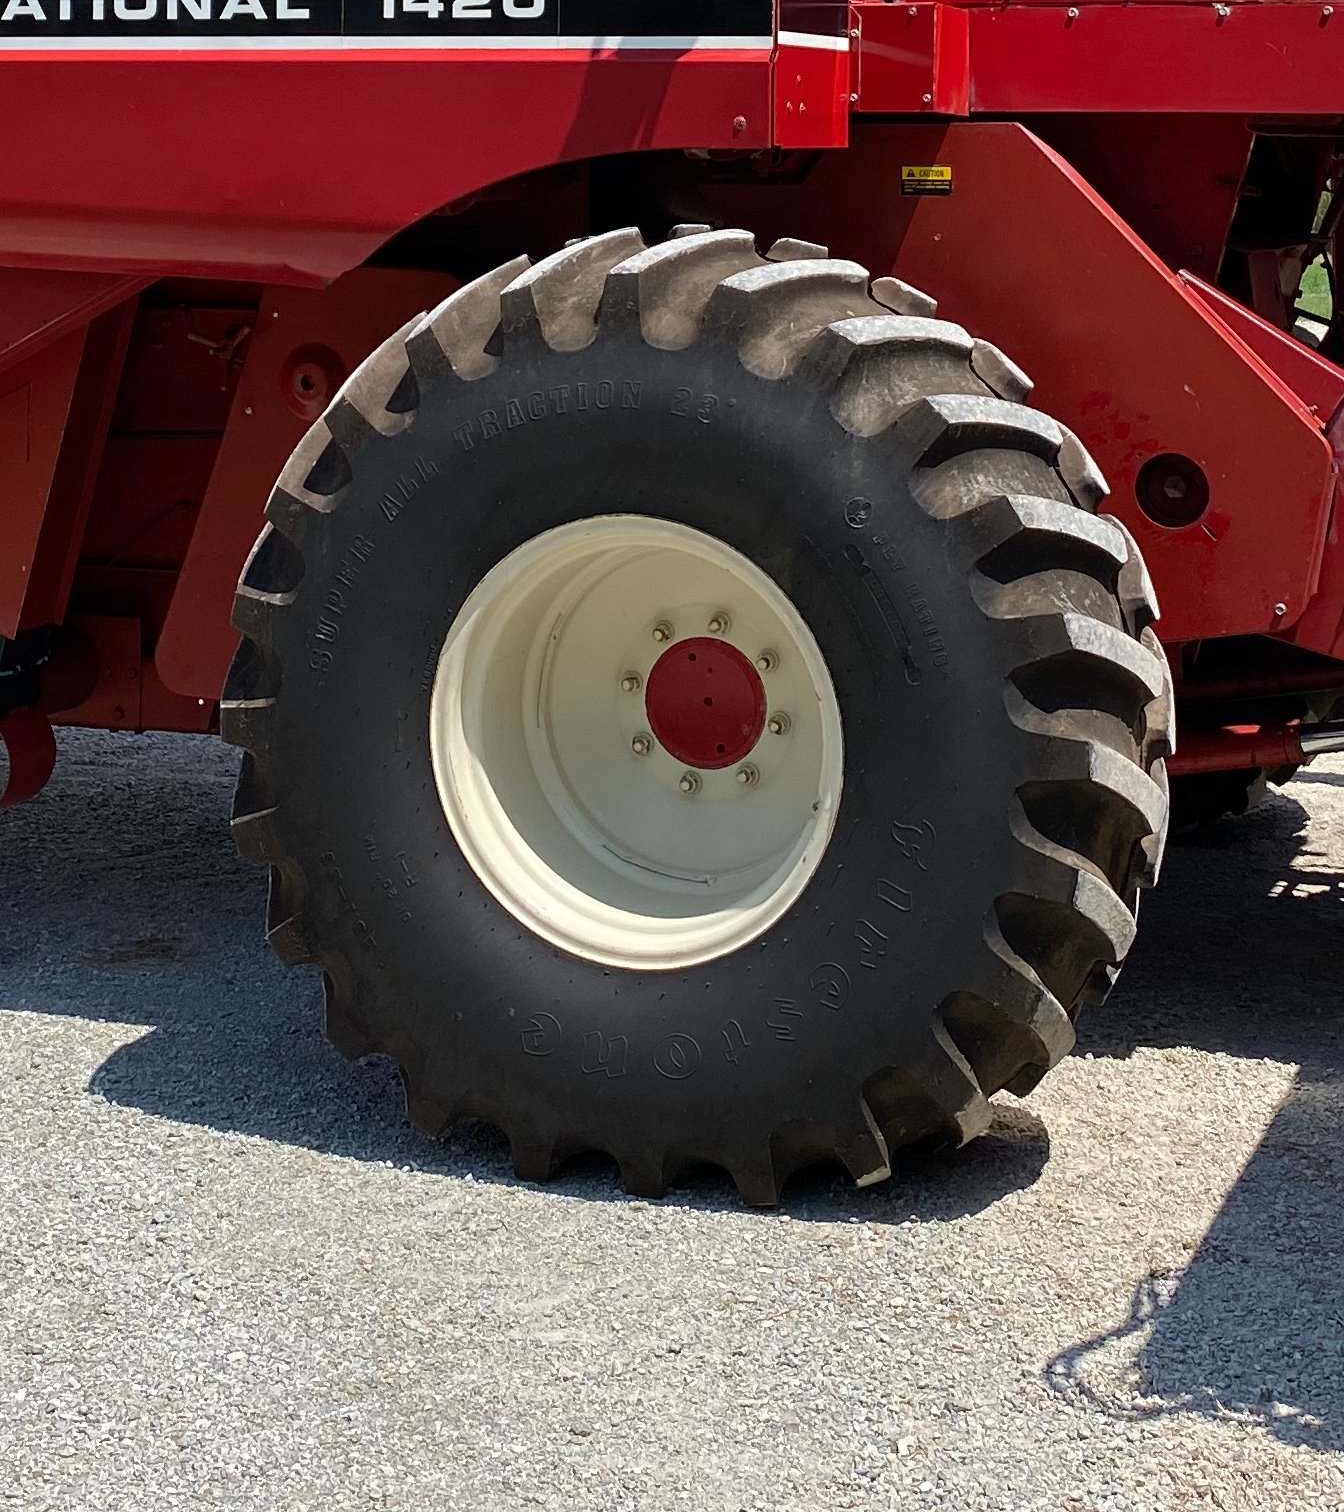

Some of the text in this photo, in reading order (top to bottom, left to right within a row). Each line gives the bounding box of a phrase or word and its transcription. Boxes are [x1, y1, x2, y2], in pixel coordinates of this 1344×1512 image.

[919, 169, 944, 178] CAUTION
[452, 379, 642, 452] TRACTION
[520, 818, 937, 1080] Firestone
